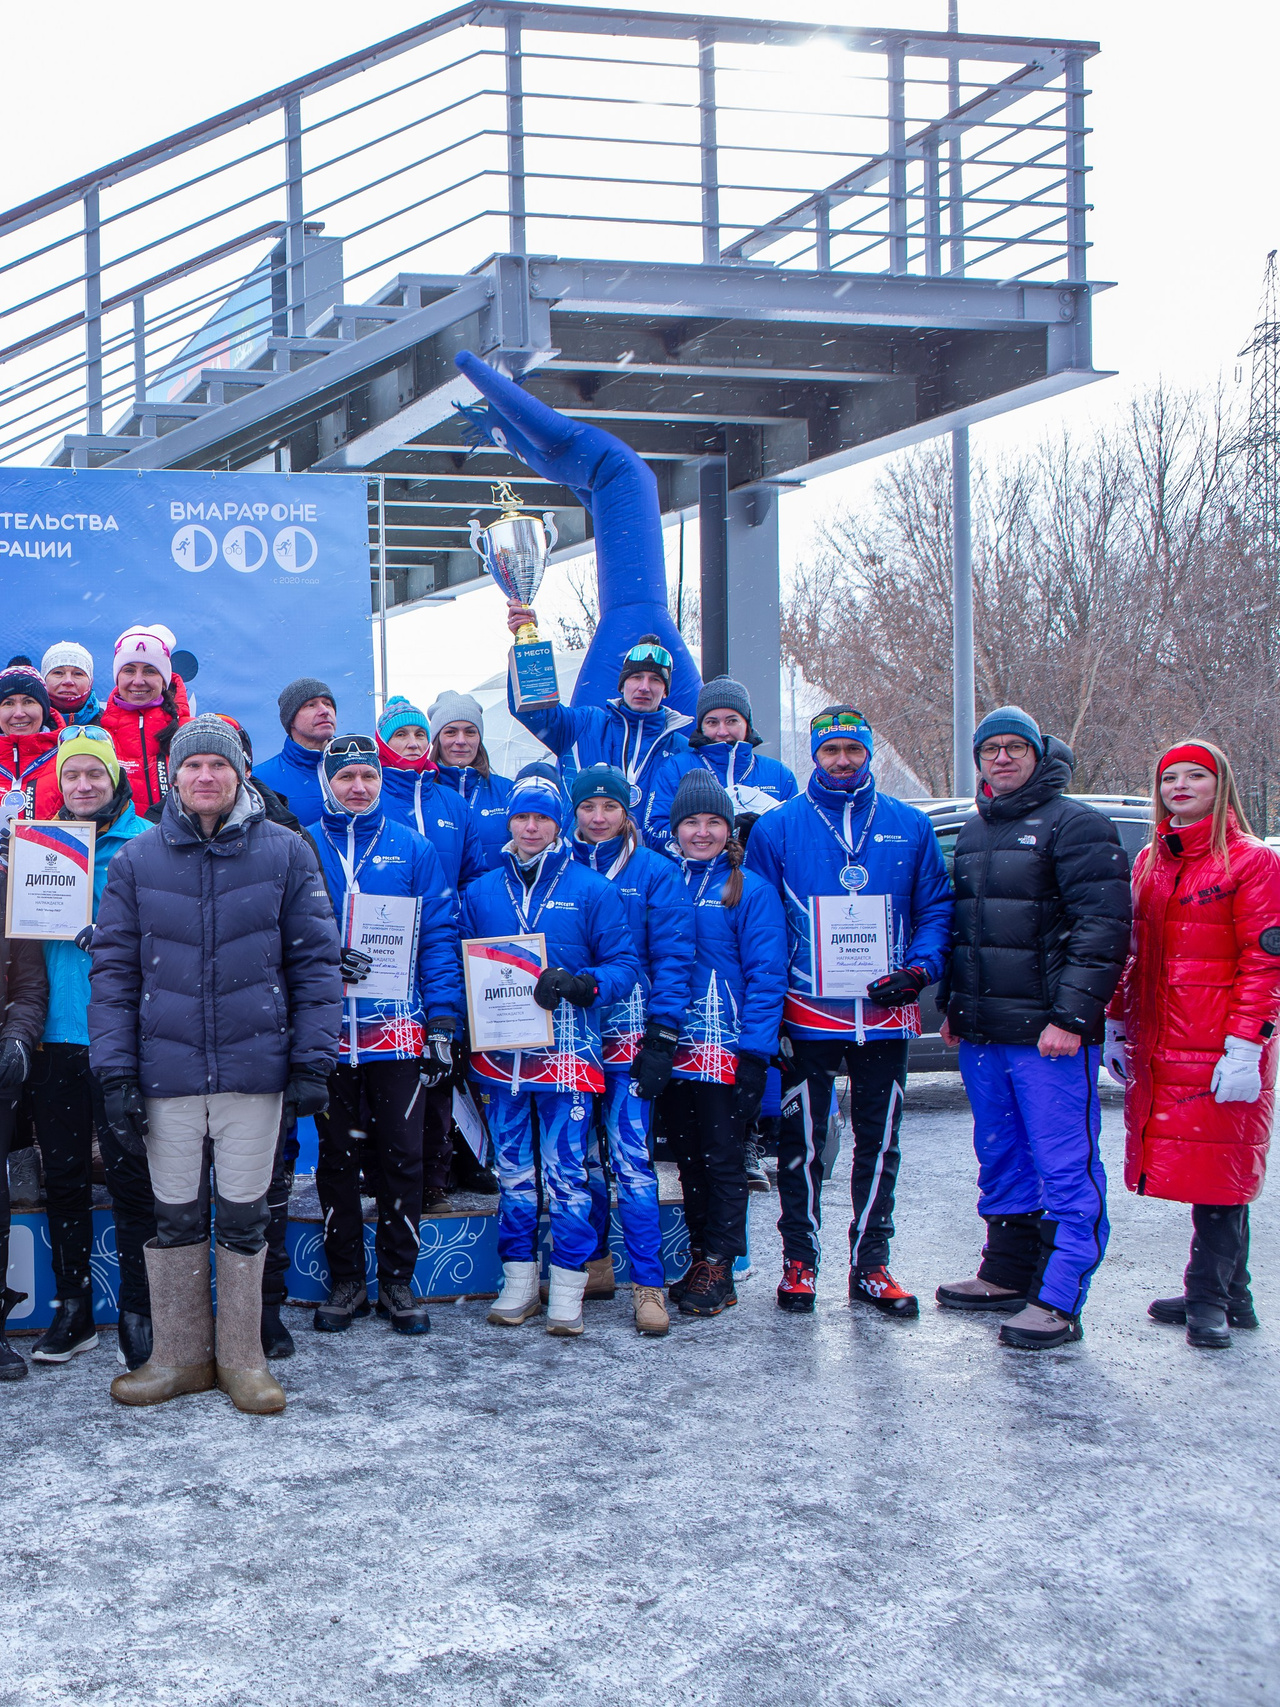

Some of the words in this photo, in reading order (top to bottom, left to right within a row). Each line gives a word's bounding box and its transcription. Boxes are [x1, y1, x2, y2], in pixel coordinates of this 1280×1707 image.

[170, 501, 318, 522] ВМАРАФОНЕ
[280, 576, 300, 584] 2020
[524, 648, 550, 657] МЕСТО
[817, 724, 857, 738] RUSSIA
[25, 874, 76, 887] ДИПЛОМ
[361, 933, 403, 945] ДИПЛОМ
[831, 933, 877, 945] ДИПЛОМ
[484, 985, 533, 1001] ДИПЛОМ
